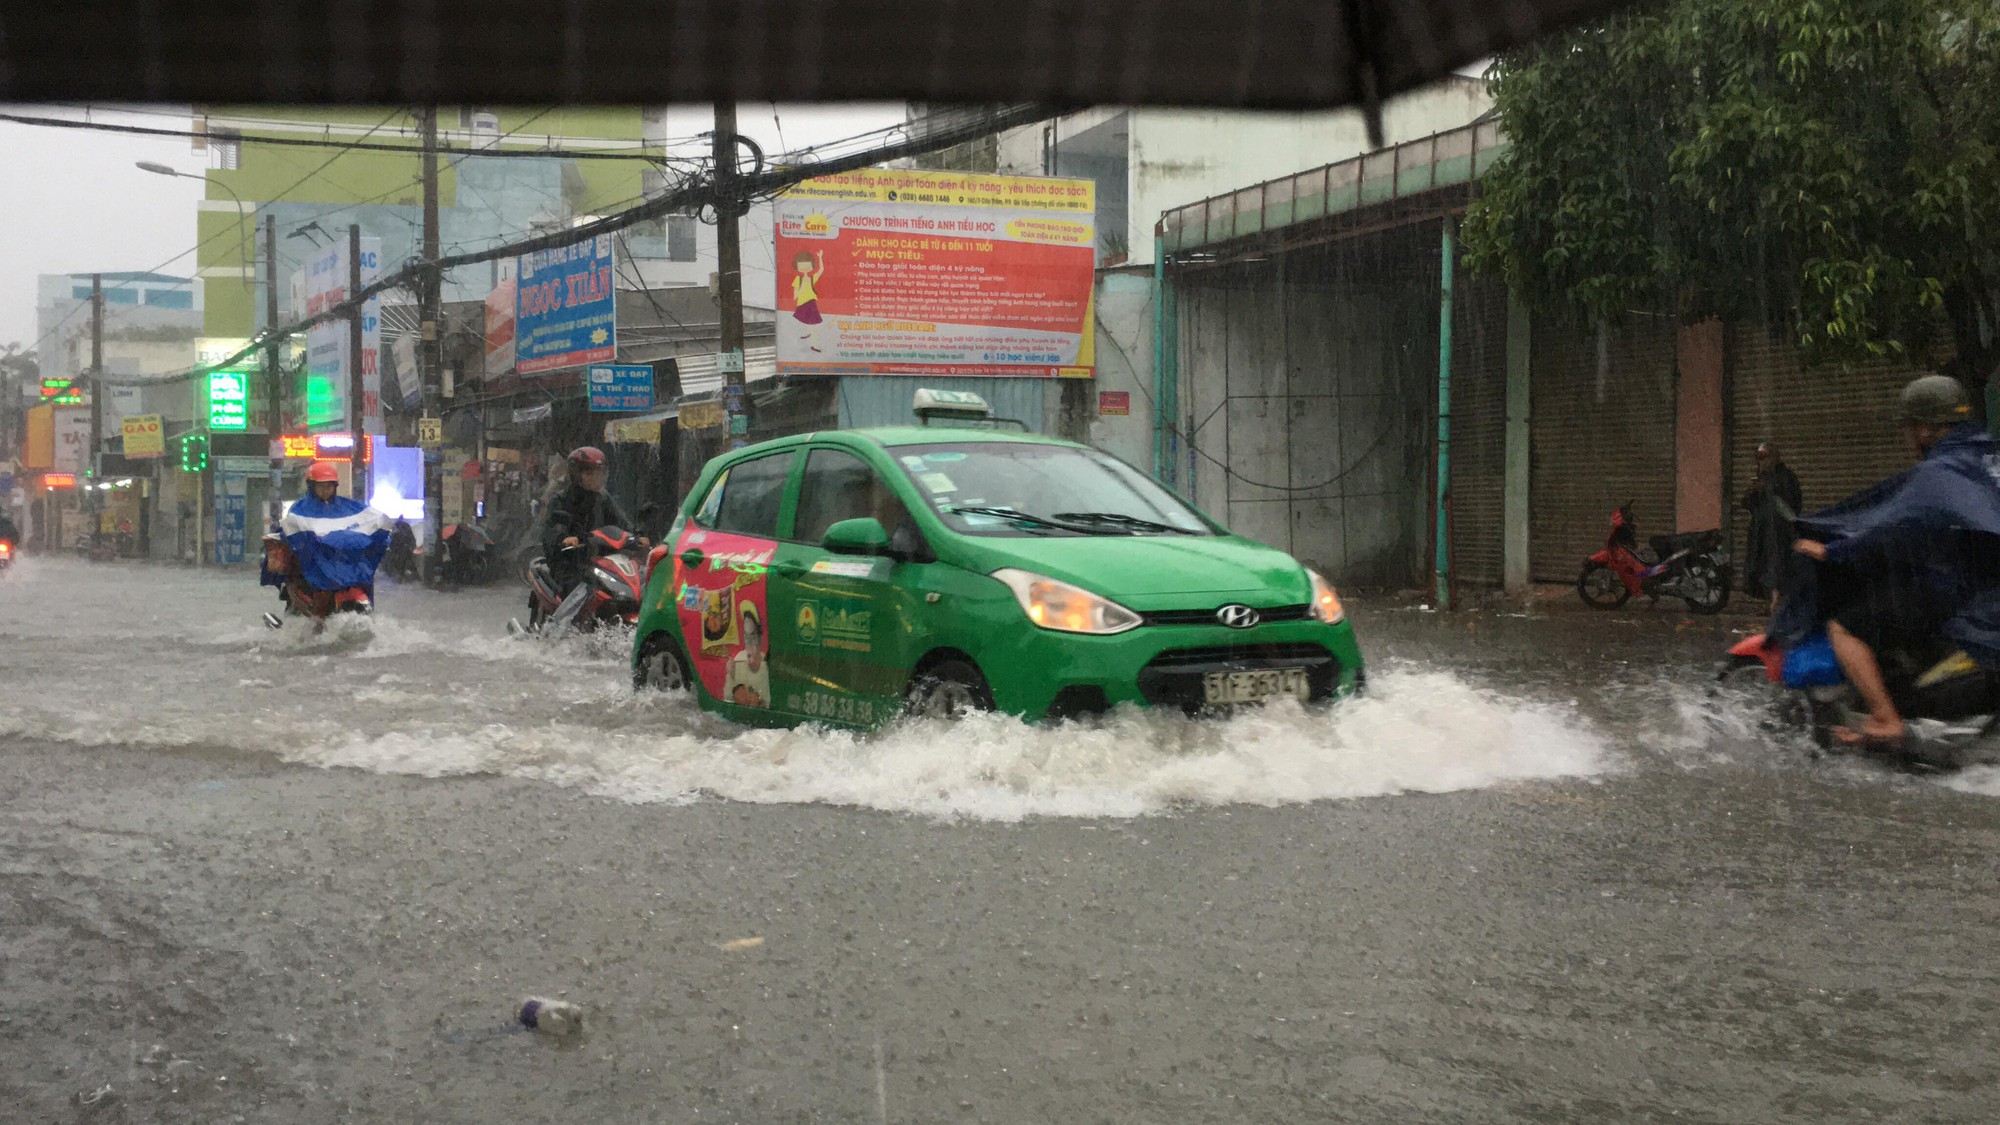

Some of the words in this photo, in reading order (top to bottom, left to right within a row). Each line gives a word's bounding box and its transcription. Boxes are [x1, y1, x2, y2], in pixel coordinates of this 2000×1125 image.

[852, 174, 875, 188] tiếng
[877, 176, 894, 186] Anh
[897, 175, 914, 190] giỏi
[916, 177, 936, 189] toàn
[938, 180, 957, 191] diện
[959, 181, 965, 190] 4
[979, 182, 1001, 195] năng
[1008, 183, 1023, 194] yêu
[1026, 183, 1046, 194] thích
[1049, 184, 1064, 197] đọc
[1067, 184, 1086, 197] sách
[782, 220, 801, 231] Rite
[805, 220, 827, 231] Care
[842, 216, 881, 228] CHƯƠNG
[884, 215, 908, 228] TRÌNH
[910, 215, 934, 229] TIẾNG
[937, 220, 955, 231] ANH
[957, 217, 974, 232] TIỂU
[976, 221, 996, 234] HỌC
[856, 237, 879, 248] DÀNH
[881, 239, 899, 248] CHO
[900, 238, 918, 249] CÁC
[920, 238, 929, 250] BÉ
[941, 241, 947, 250] 6
[948, 240, 963, 251] ĐẾN
[965, 242, 973, 252] 11
[975, 240, 993, 252] TUỔI
[866, 250, 894, 262] MỤC
[898, 250, 924, 260] TIÊU:
[877, 262, 891, 270] tạo
[909, 262, 927, 270] toàn
[928, 264, 946, 273] diện
[964, 266, 985, 274] năng
[520, 278, 561, 320] NGỌC
[566, 260, 611, 308] XUÂN
[1008, 354, 1022, 362] học
[616, 370, 628, 378] XE
[592, 384, 602, 392] XE
[607, 382, 623, 392] THỂ
[628, 384, 650, 392] THAO
